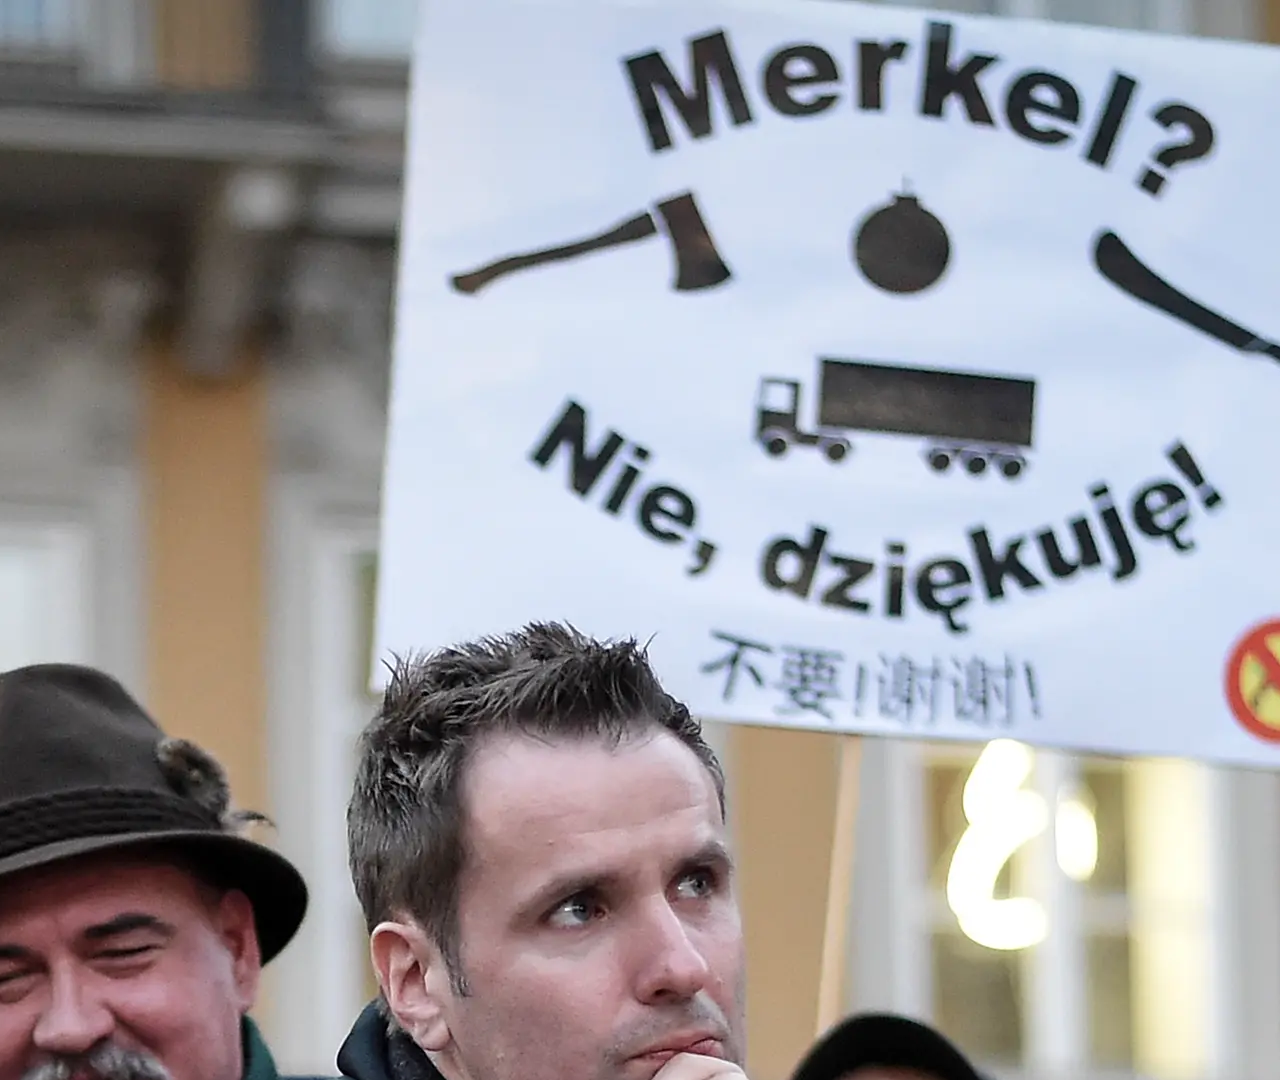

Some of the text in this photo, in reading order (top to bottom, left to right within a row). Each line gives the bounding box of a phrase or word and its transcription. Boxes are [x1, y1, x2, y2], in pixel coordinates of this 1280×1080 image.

[622, 22, 1216, 197] Merkel?
[531, 401, 1223, 634] Nie, dziękuję!
